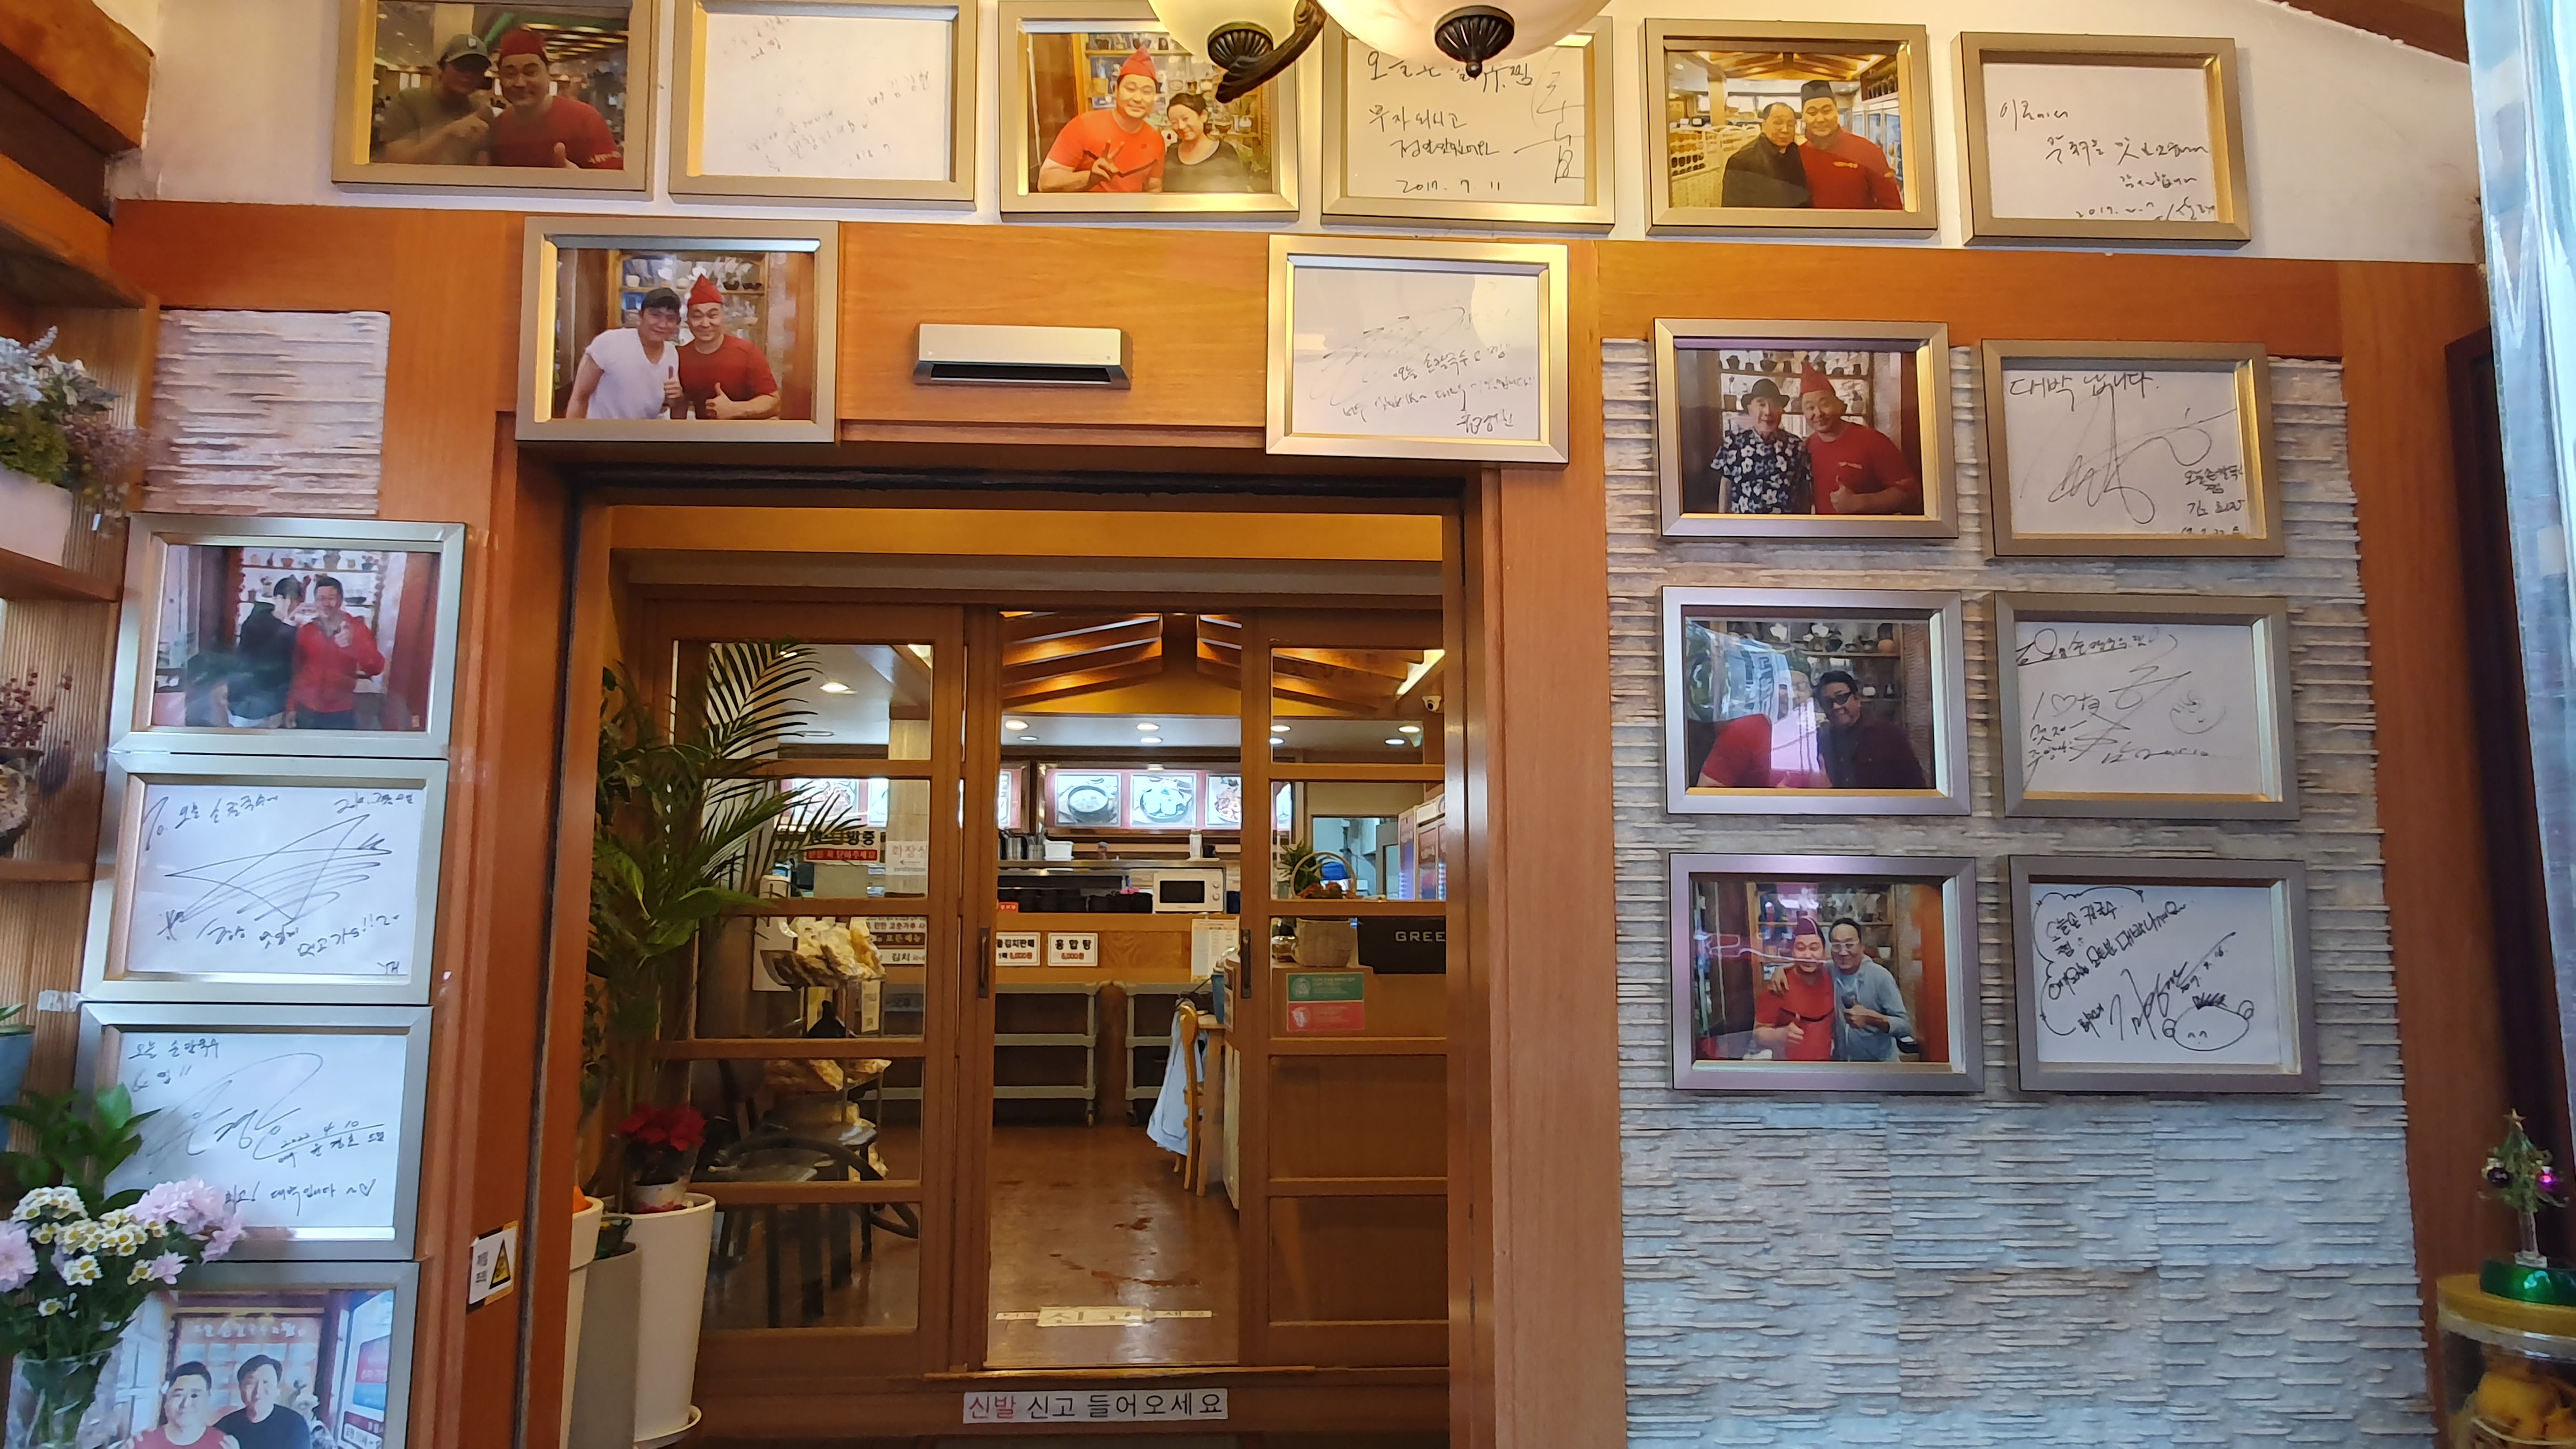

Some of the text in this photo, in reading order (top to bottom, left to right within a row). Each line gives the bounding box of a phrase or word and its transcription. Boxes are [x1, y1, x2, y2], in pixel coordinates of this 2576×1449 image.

[968, 1391, 1223, 1420] 신발 신고 들어오세요
